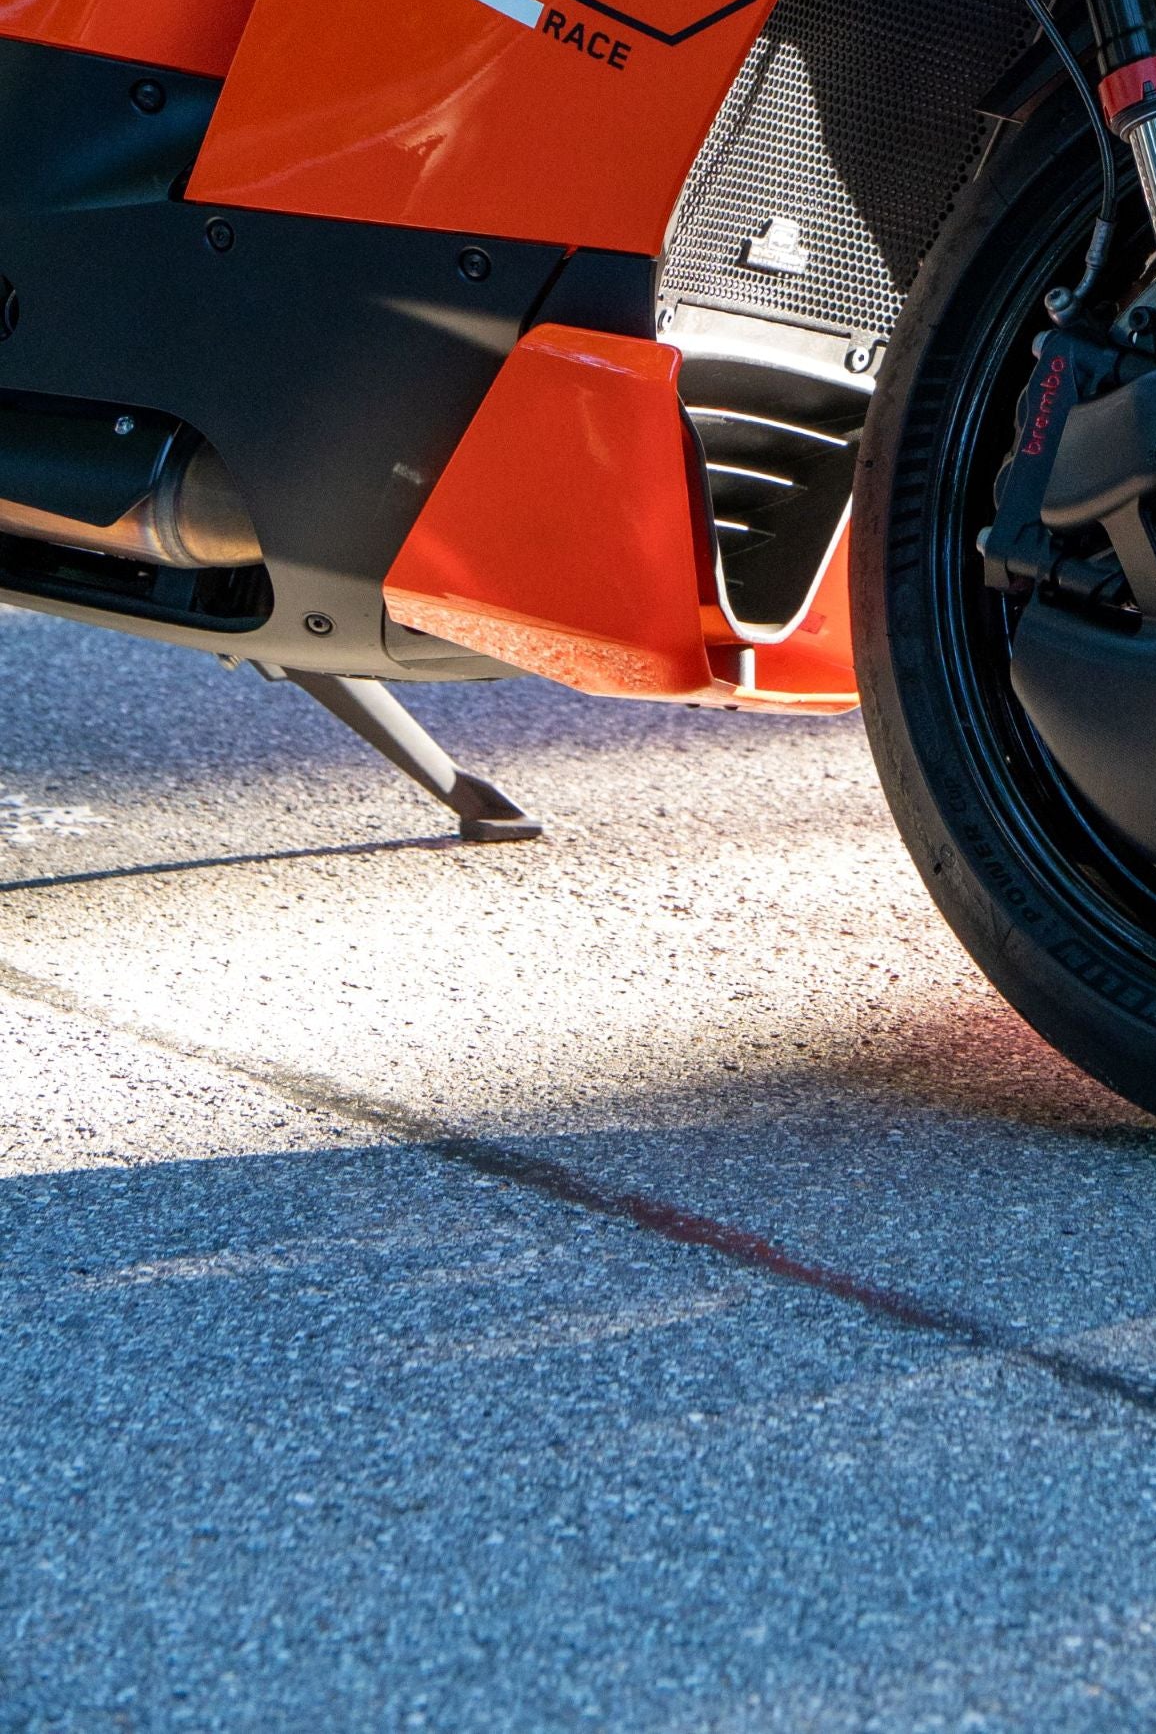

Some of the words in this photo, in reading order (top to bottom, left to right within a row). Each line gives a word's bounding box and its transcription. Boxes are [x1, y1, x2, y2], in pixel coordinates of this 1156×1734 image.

[541, 8, 633, 71] RACE
[1020, 356, 1065, 456] brembo
[961, 819, 1045, 930] POWER
